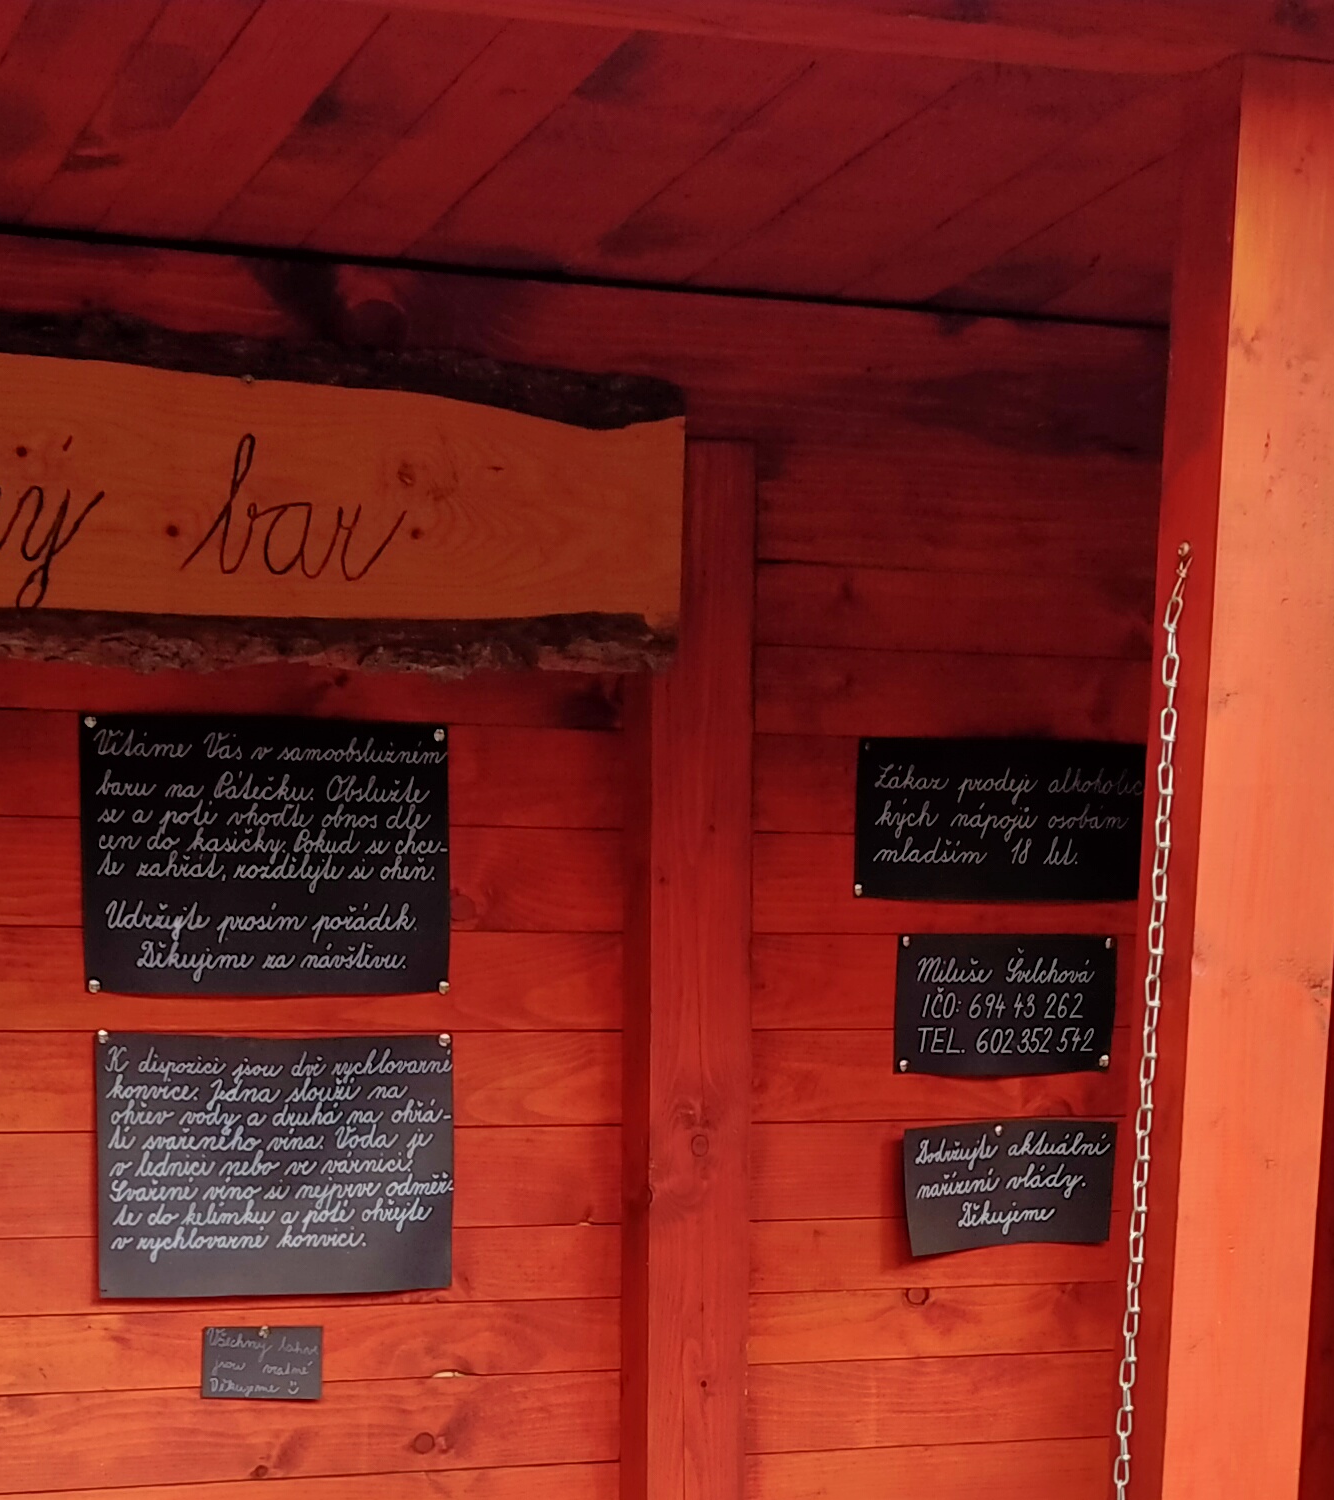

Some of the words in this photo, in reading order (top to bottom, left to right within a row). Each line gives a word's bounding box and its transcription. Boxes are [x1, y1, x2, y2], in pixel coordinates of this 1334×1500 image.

[179, 433, 408, 582] bar
[93, 729, 193, 758] Vítáme
[204, 731, 242, 760] Vás
[251, 746, 273, 761] v
[277, 737, 448, 764] samoobslužném
[96, 769, 157, 796] baru
[165, 784, 205, 798] na
[326, 774, 431, 804] Obslužte
[874, 763, 950, 790] Zákaz
[957, 767, 1039, 805] prodeje
[97, 806, 126, 823] se
[131, 808, 153, 823] a
[159, 799, 218, 832] poté
[226, 804, 315, 827] vhoďte
[321, 804, 378, 829] obnos
[388, 804, 432, 830] dle
[875, 798, 940, 839] kých
[950, 802, 1038, 842] nápojů
[1047, 804, 1130, 829] osobám
[98, 834, 143, 849] cen
[146, 826, 180, 849] do
[187, 827, 286, 862] kasičky.
[293, 829, 361, 853] Pokud
[365, 838, 391, 854] se
[395, 829, 448, 854] chce-
[873, 837, 988, 864] mladším
[1011, 838, 1031, 865] 18
[1043, 837, 1079, 865] let.
[96, 852, 125, 876] te
[136, 850, 227, 882] zahřát,
[233, 853, 345, 893] rozdělejte
[348, 859, 375, 879] si
[379, 859, 436, 881] oheň.
[105, 900, 213, 941] Udržujte
[216, 902, 309, 943] prosím
[312, 902, 417, 943] pořádek.
[136, 940, 256, 982] Děkujeme
[261, 954, 296, 969] za
[300, 942, 406, 970] návštěvu.
[917, 957, 994, 983] Miluše
[1005, 947, 1096, 984] Švelchová
[921, 987, 962, 1020] IČO:
[968, 992, 1006, 1020] 694
[1013, 993, 1035, 1019] 43
[1044, 992, 1084, 1020] 262
[917, 1027, 965, 1054] TEL.
[976, 1027, 1014, 1054] 602
[1016, 1027, 1053, 1053] 352
[1056, 1027, 1095, 1052] 542
[105, 1046, 128, 1072] K
[138, 1047, 226, 1081] dispozici
[232, 1058, 283, 1079] jsou
[291, 1051, 326, 1078] dvě
[331, 1048, 452, 1082] rychlovarné
[105, 1074, 198, 1101] konvice.
[206, 1079, 282, 1110] Jedna
[288, 1078, 362, 1103] slouží
[367, 1084, 408, 1100] na
[110, 1099, 174, 1125] ohřev
[179, 1104, 242, 1134] vody
[246, 1112, 267, 1126] a
[272, 1100, 343, 1125] druhá
[346, 1108, 382, 1124] na
[390, 1098, 451, 1124] ohřá-
[108, 1125, 135, 1150] tí
[141, 1126, 258, 1151] svařeného
[266, 1126, 325, 1151] vína.
[335, 1125, 399, 1149] Voda
[406, 1129, 433, 1158] je
[915, 1134, 999, 1171] Dodržujte
[1007, 1131, 1111, 1157] aktuální
[108, 1159, 133, 1177] v
[135, 1151, 216, 1176] lednici
[219, 1149, 281, 1176] nebo
[284, 1158, 318, 1176] ve
[320, 1151, 413, 1175] várnici.
[109, 1178, 199, 1202] Svařené
[202, 1179, 261, 1201] víno
[263, 1178, 290, 1200] si
[295, 1176, 382, 1209] nejprve
[917, 1167, 1001, 1200] nařízení
[1005, 1163, 1087, 1199] vlády.
[113, 1207, 143, 1226] te
[148, 1208, 180, 1226] do
[181, 1201, 276, 1226] kelímku
[280, 1208, 299, 1225] a
[302, 1199, 356, 1232] poté
[361, 1197, 433, 1233] ohřejte
[958, 1201, 1056, 1235] Děkujeme
[110, 1234, 134, 1251] v
[136, 1225, 269, 1262] rychlovarné
[276, 1224, 367, 1251] konvici.
